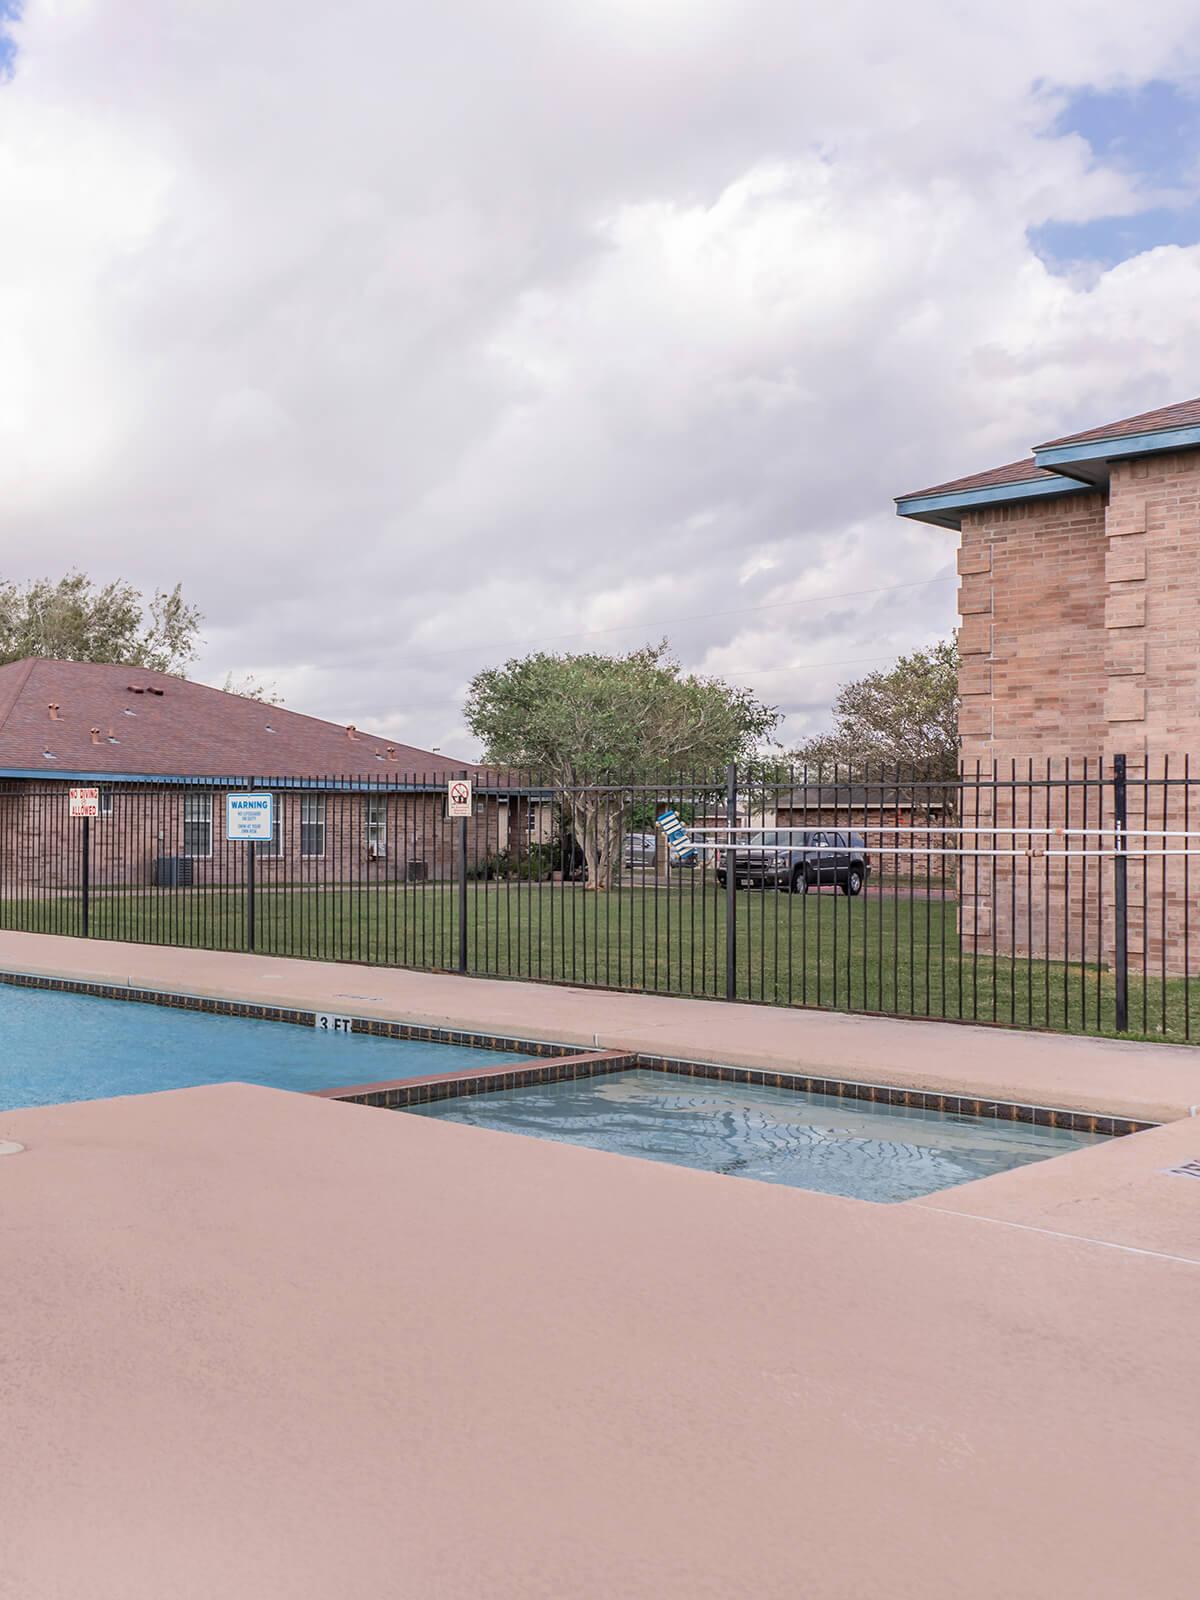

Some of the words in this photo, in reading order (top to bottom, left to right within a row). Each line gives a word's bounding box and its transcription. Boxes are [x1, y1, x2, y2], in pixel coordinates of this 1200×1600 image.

[69, 789, 77, 799] NO
[80, 789, 98, 799] DIVING
[231, 800, 268, 809] WARNING
[71, 805, 97, 815] ALLOWED
[320, 1016, 328, 1030] 3
[334, 1017, 351, 1032] FT
